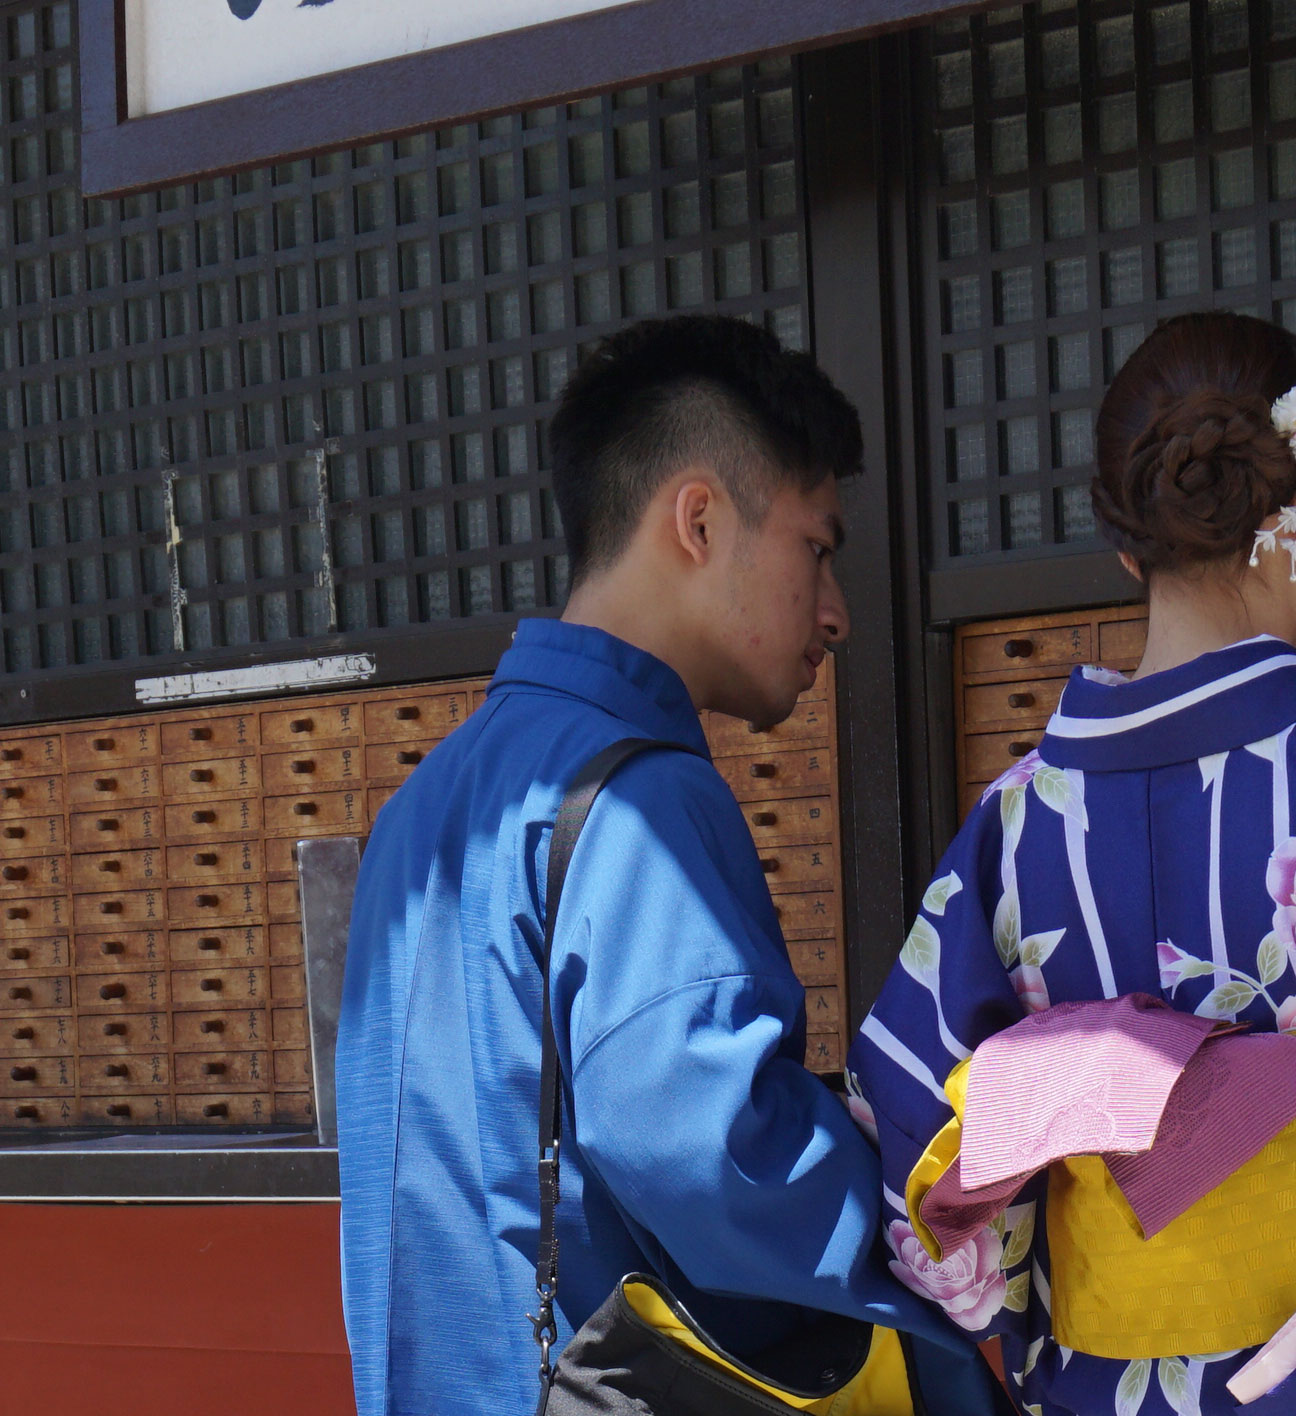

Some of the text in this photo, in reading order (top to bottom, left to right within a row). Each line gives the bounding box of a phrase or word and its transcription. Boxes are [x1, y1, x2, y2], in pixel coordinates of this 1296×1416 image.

[340, 707, 351, 731] 四十一
[449, 697, 458, 723] 三十一
[807, 711, 818, 724] 二
[139, 728, 147, 750] 六十一
[238, 717, 246, 743] 五十一
[45, 740, 53, 760] 七十一
[240, 759, 248, 784] 五十二
[342, 750, 352, 777] 四十二
[808, 757, 820, 770] 三
[47, 779, 56, 802] 七十二
[140, 768, 149, 793] 六十二
[241, 802, 249, 828] 五十三
[344, 793, 355, 820] 四十三
[809, 808, 820, 818] 四
[48, 818, 56, 842] 七十三
[143, 810, 152, 837] 六十三
[143, 851, 152, 877] 六十四
[241, 843, 250, 870] 五十四
[811, 853, 823, 866] 五
[50, 858, 59, 883] 七十四
[146, 891, 155, 917] 六十五
[244, 885, 253, 912] 五十五
[813, 900, 825, 914] 六
[53, 899, 61, 924] 七十五
[53, 939, 61, 963] 七十六
[146, 932, 155, 958] 六十六
[246, 929, 254, 955] 五十六
[815, 947, 825, 960] 七
[54, 979, 62, 1003] 七十七
[147, 974, 157, 1000] 六十七
[248, 969, 256, 995] 五十七
[816, 995, 828, 1010] 八
[56, 1018, 65, 1044] 七十八
[150, 1016, 160, 1041] 六十八
[249, 1012, 258, 1039] 五十八
[818, 1042, 829, 1057] 九
[58, 1058, 67, 1084] 七十九
[151, 1056, 161, 1083] 六十九
[250, 1053, 259, 1080] 五十九
[61, 1100, 70, 1122] 八十
[154, 1098, 163, 1120] 七十
[253, 1098, 262, 1120] 六十
